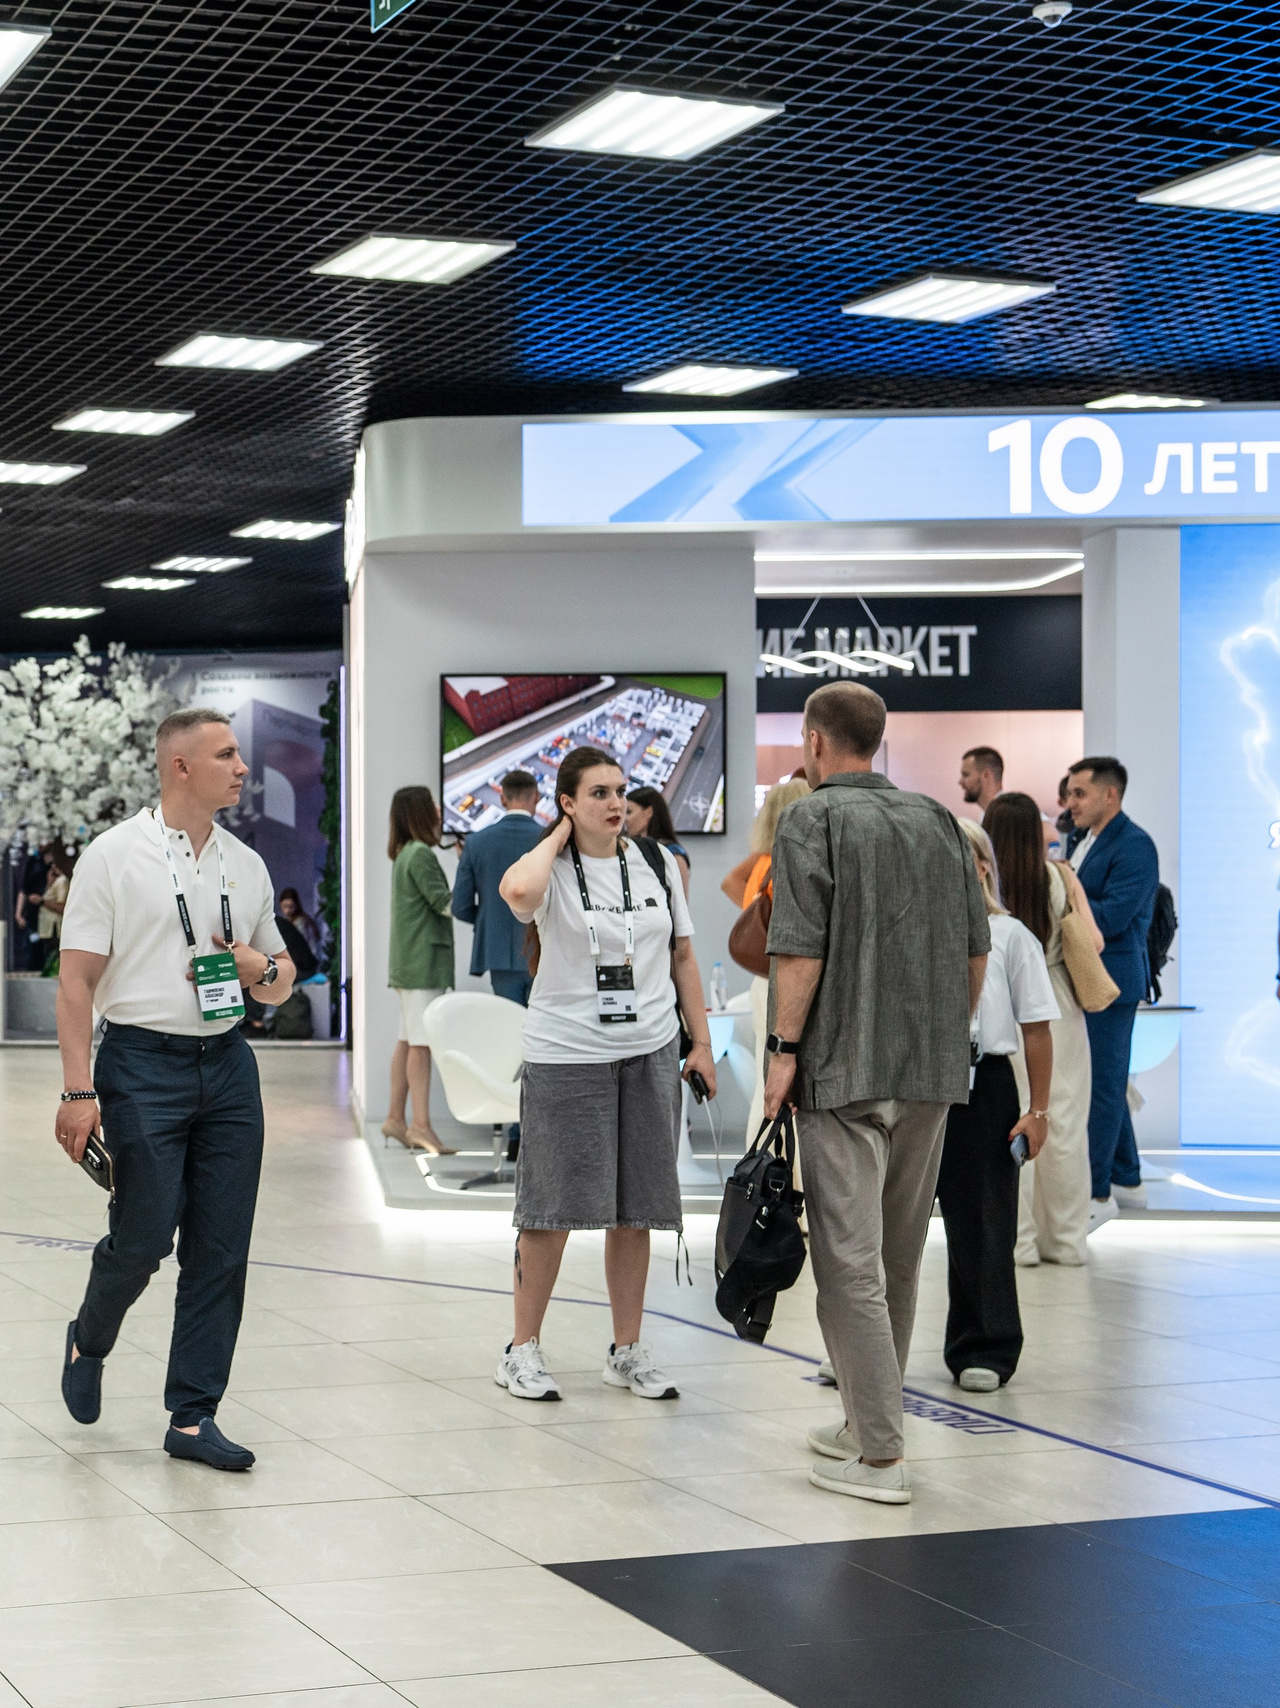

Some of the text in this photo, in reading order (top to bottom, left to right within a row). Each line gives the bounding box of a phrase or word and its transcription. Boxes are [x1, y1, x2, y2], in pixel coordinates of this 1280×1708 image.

[988, 416, 1280, 515] 10 ЛЕТ
[815, 625, 977, 678] МАРКЕТ
